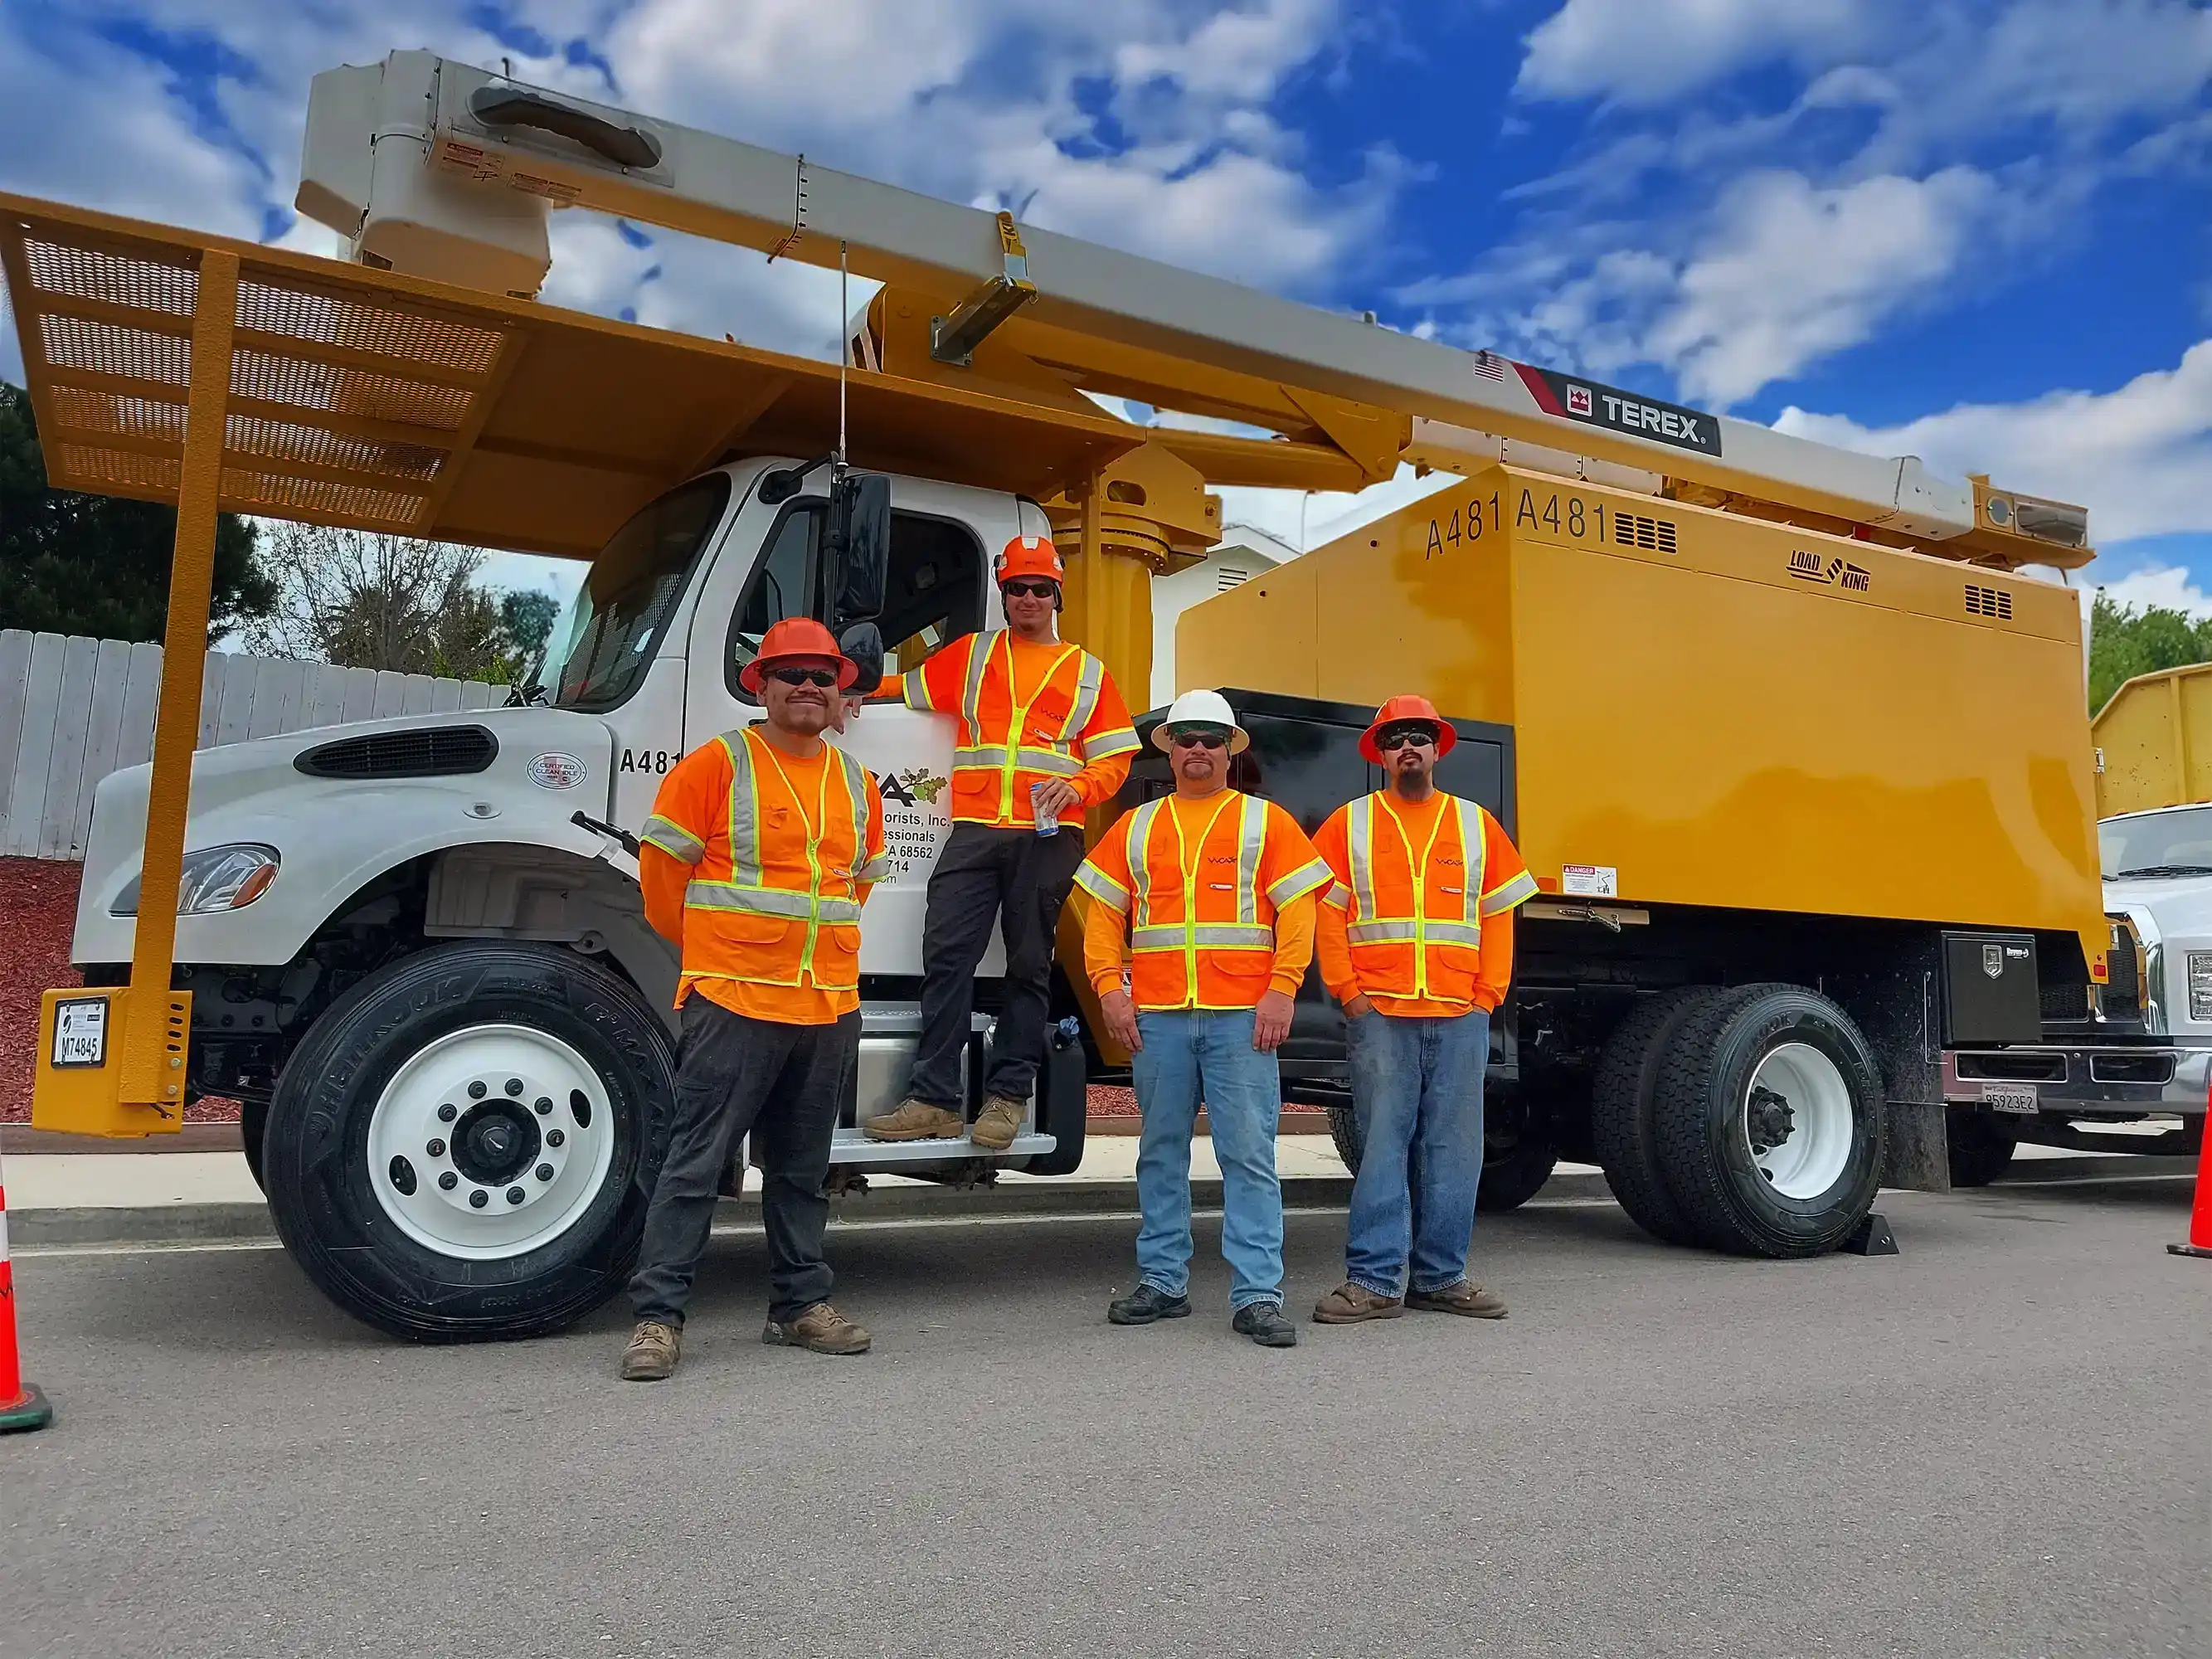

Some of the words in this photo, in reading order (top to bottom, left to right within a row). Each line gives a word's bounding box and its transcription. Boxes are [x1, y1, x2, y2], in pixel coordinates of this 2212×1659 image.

[1425, 490, 1500, 561] A481
[1516, 488, 1605, 542] A481
[1791, 549, 1821, 572] LOAD
[1840, 571, 1869, 592] KING
[928, 814, 950, 827] Inc.
[900, 846, 933, 859] 68562
[61, 1037, 97, 1057] M74845
